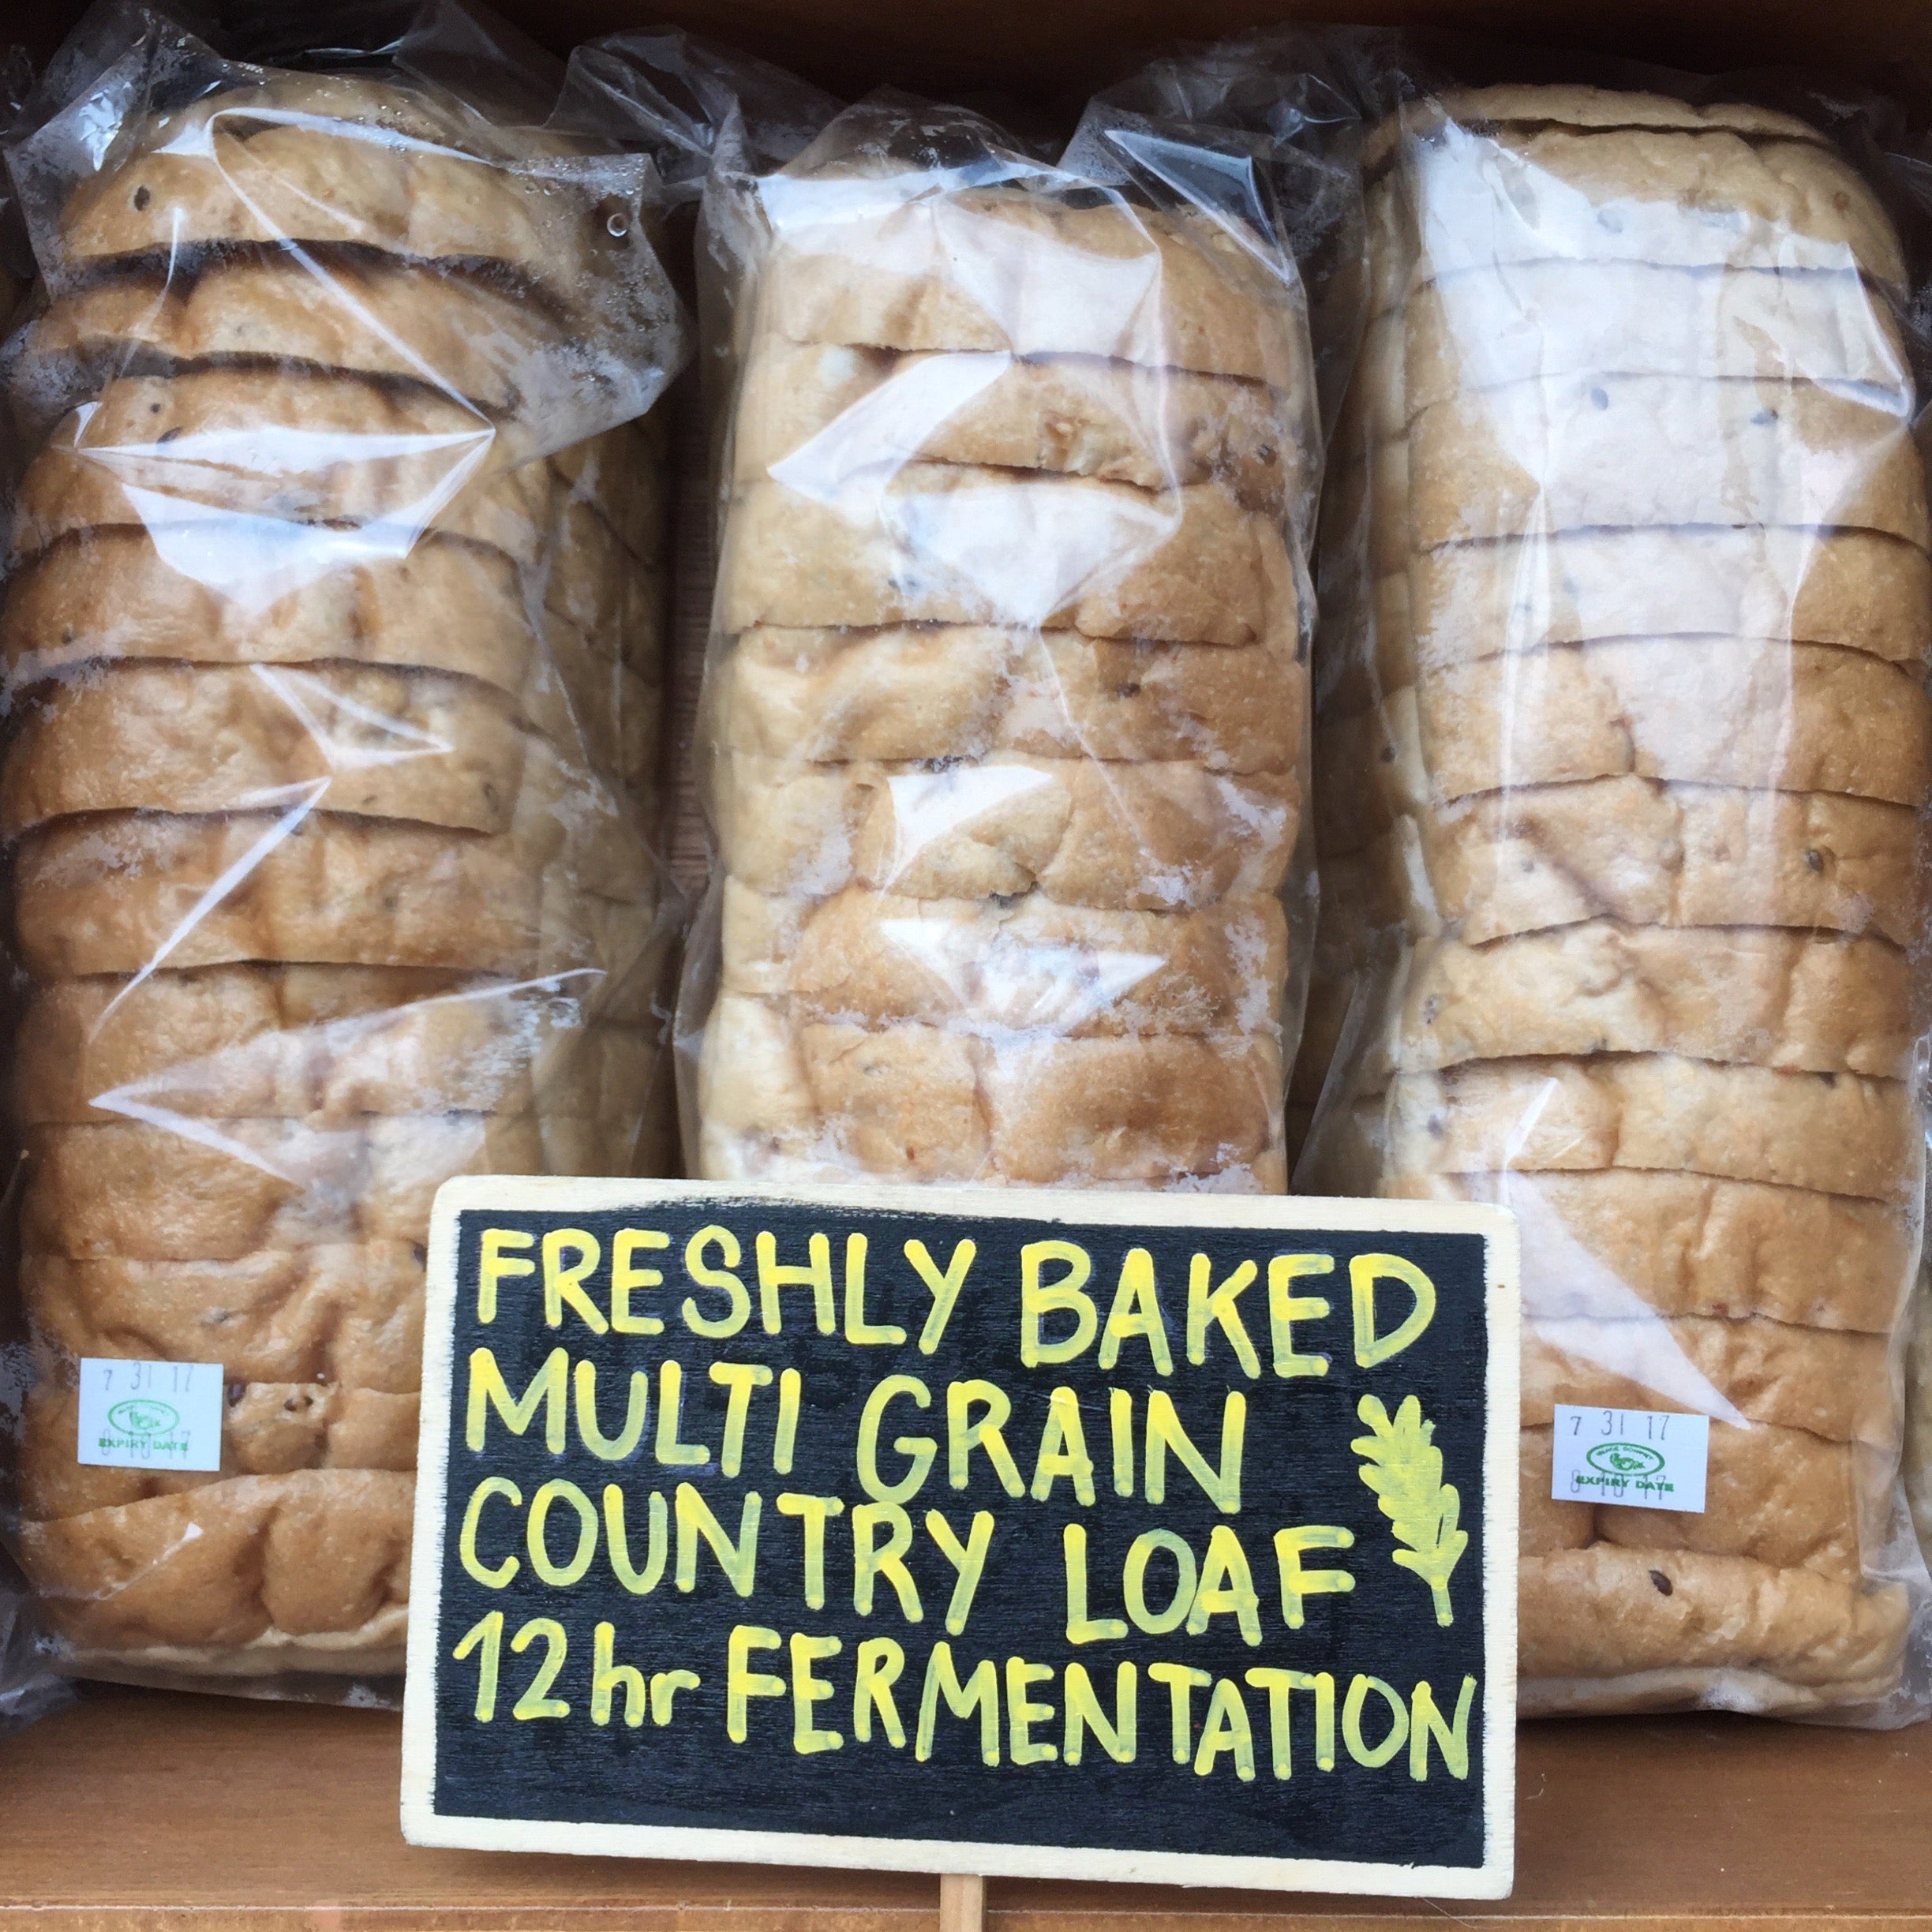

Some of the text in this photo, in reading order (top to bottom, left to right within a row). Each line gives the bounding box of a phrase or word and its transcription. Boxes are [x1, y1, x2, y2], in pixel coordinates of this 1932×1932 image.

[476, 1225, 1436, 1380] FRESHLY BAKED
[467, 1346, 1246, 1515] MULTI GRAIN
[1570, 1410, 1670, 1440] 7 31 17
[1575, 1475, 1675, 1492] EXPIRY DATE
[460, 1477, 1356, 1646] COUNTRY LOAF
[725, 1624, 1477, 1783] FERMENTATION
